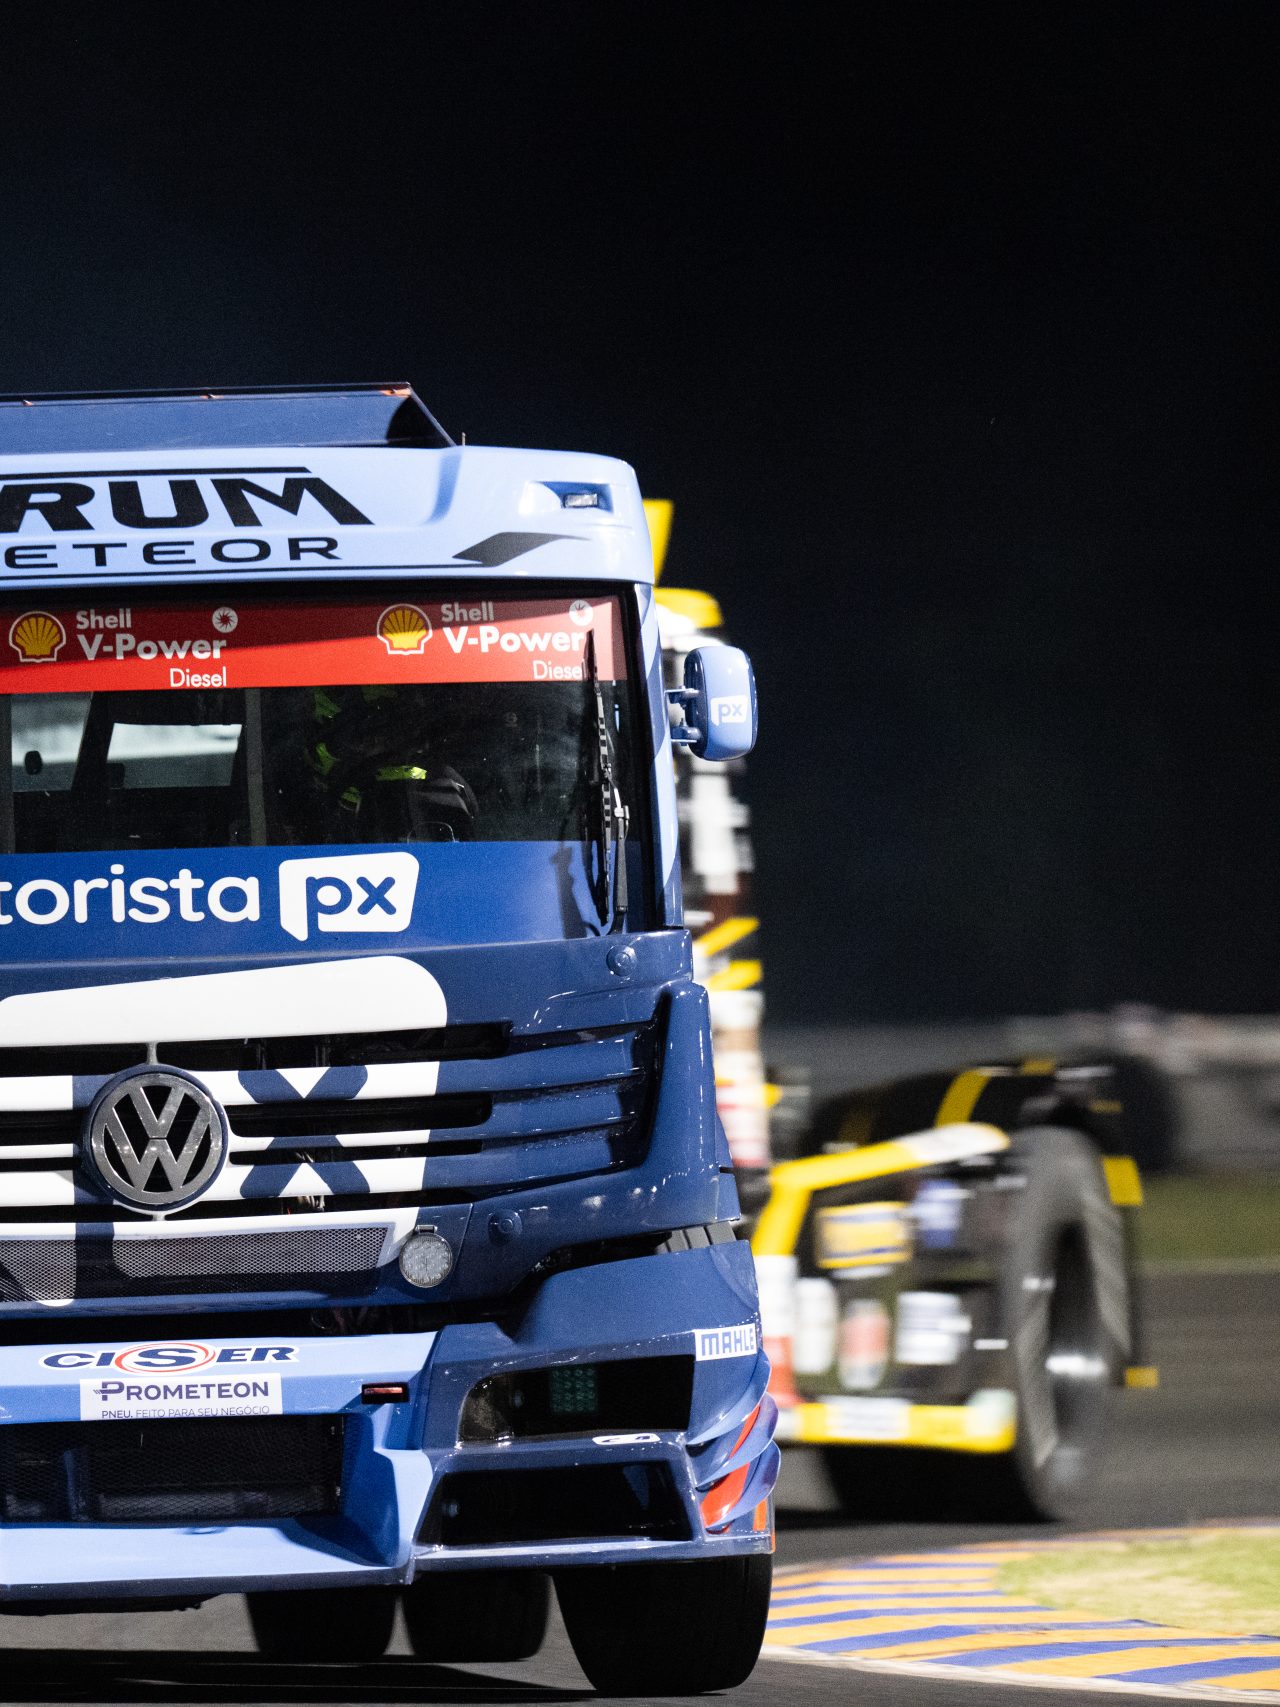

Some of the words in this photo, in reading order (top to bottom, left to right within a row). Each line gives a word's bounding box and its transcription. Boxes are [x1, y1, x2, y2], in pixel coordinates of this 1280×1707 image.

[76, 608, 132, 630] Shell
[441, 602, 494, 622] Shell
[77, 633, 227, 661] V-Power
[443, 625, 585, 653] V-Power
[170, 666, 227, 688] Diesel
[718, 703, 742, 723] px
[305, 874, 398, 934] px
[92, 1074, 223, 1202] VW
[700, 1328, 754, 1357] MAHLE
[43, 1345, 296, 1369] CISER
[100, 1381, 269, 1401] PROMETEON
[101, 1410, 133, 1419] PNEU.
[136, 1409, 166, 1418] FEITO
[168, 1408, 196, 1417] PARA
[197, 1407, 220, 1417] SEU
[221, 1404, 270, 1416] NEGÓCIO
